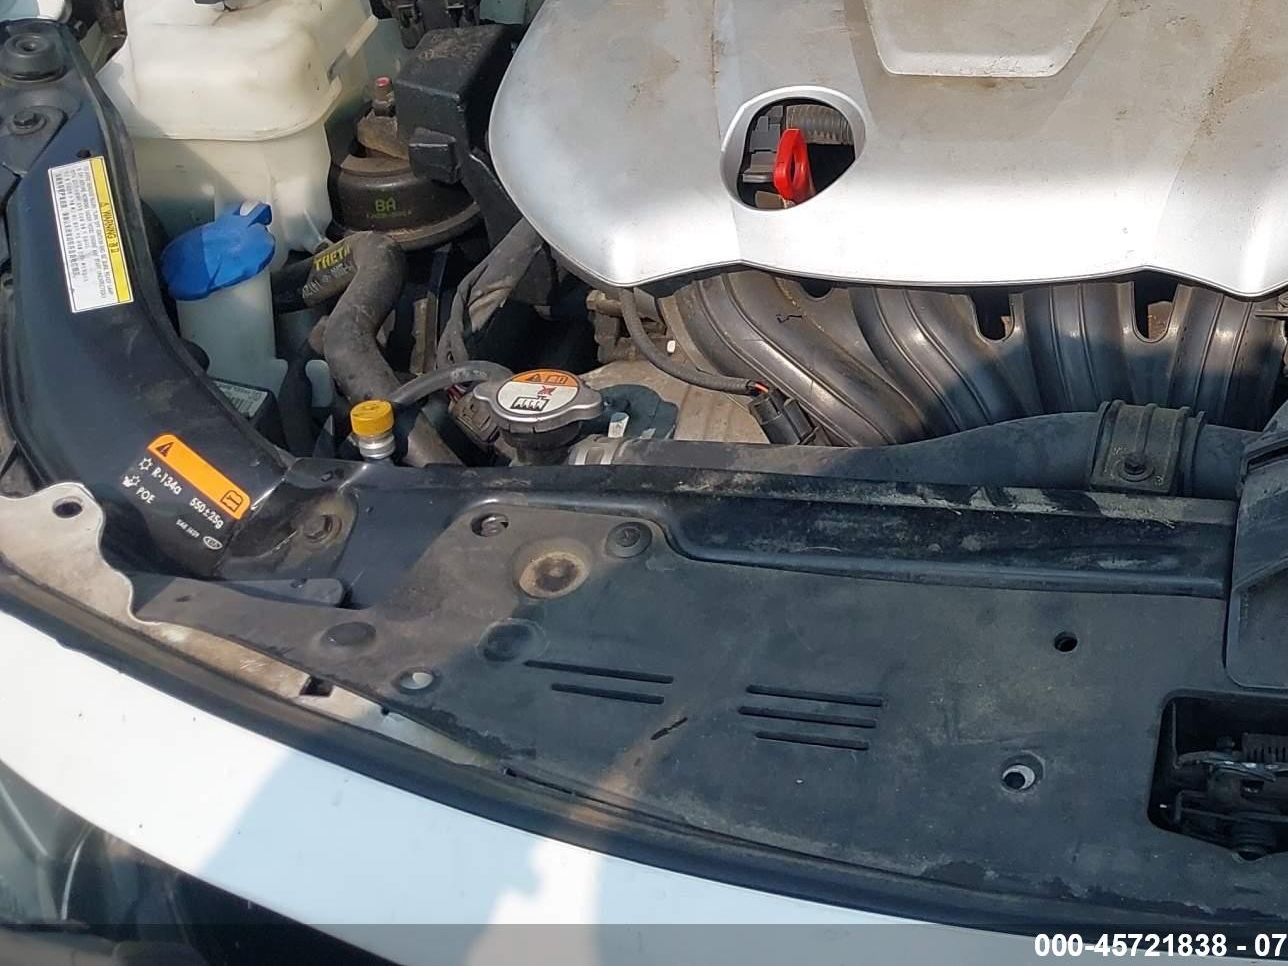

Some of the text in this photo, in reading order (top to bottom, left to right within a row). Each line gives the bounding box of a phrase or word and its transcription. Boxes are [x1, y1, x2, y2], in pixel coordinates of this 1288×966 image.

[104, 208, 117, 240] WARNING
[135, 487, 156, 504] POE
[151, 468, 225, 530] R-134a 550±25g
